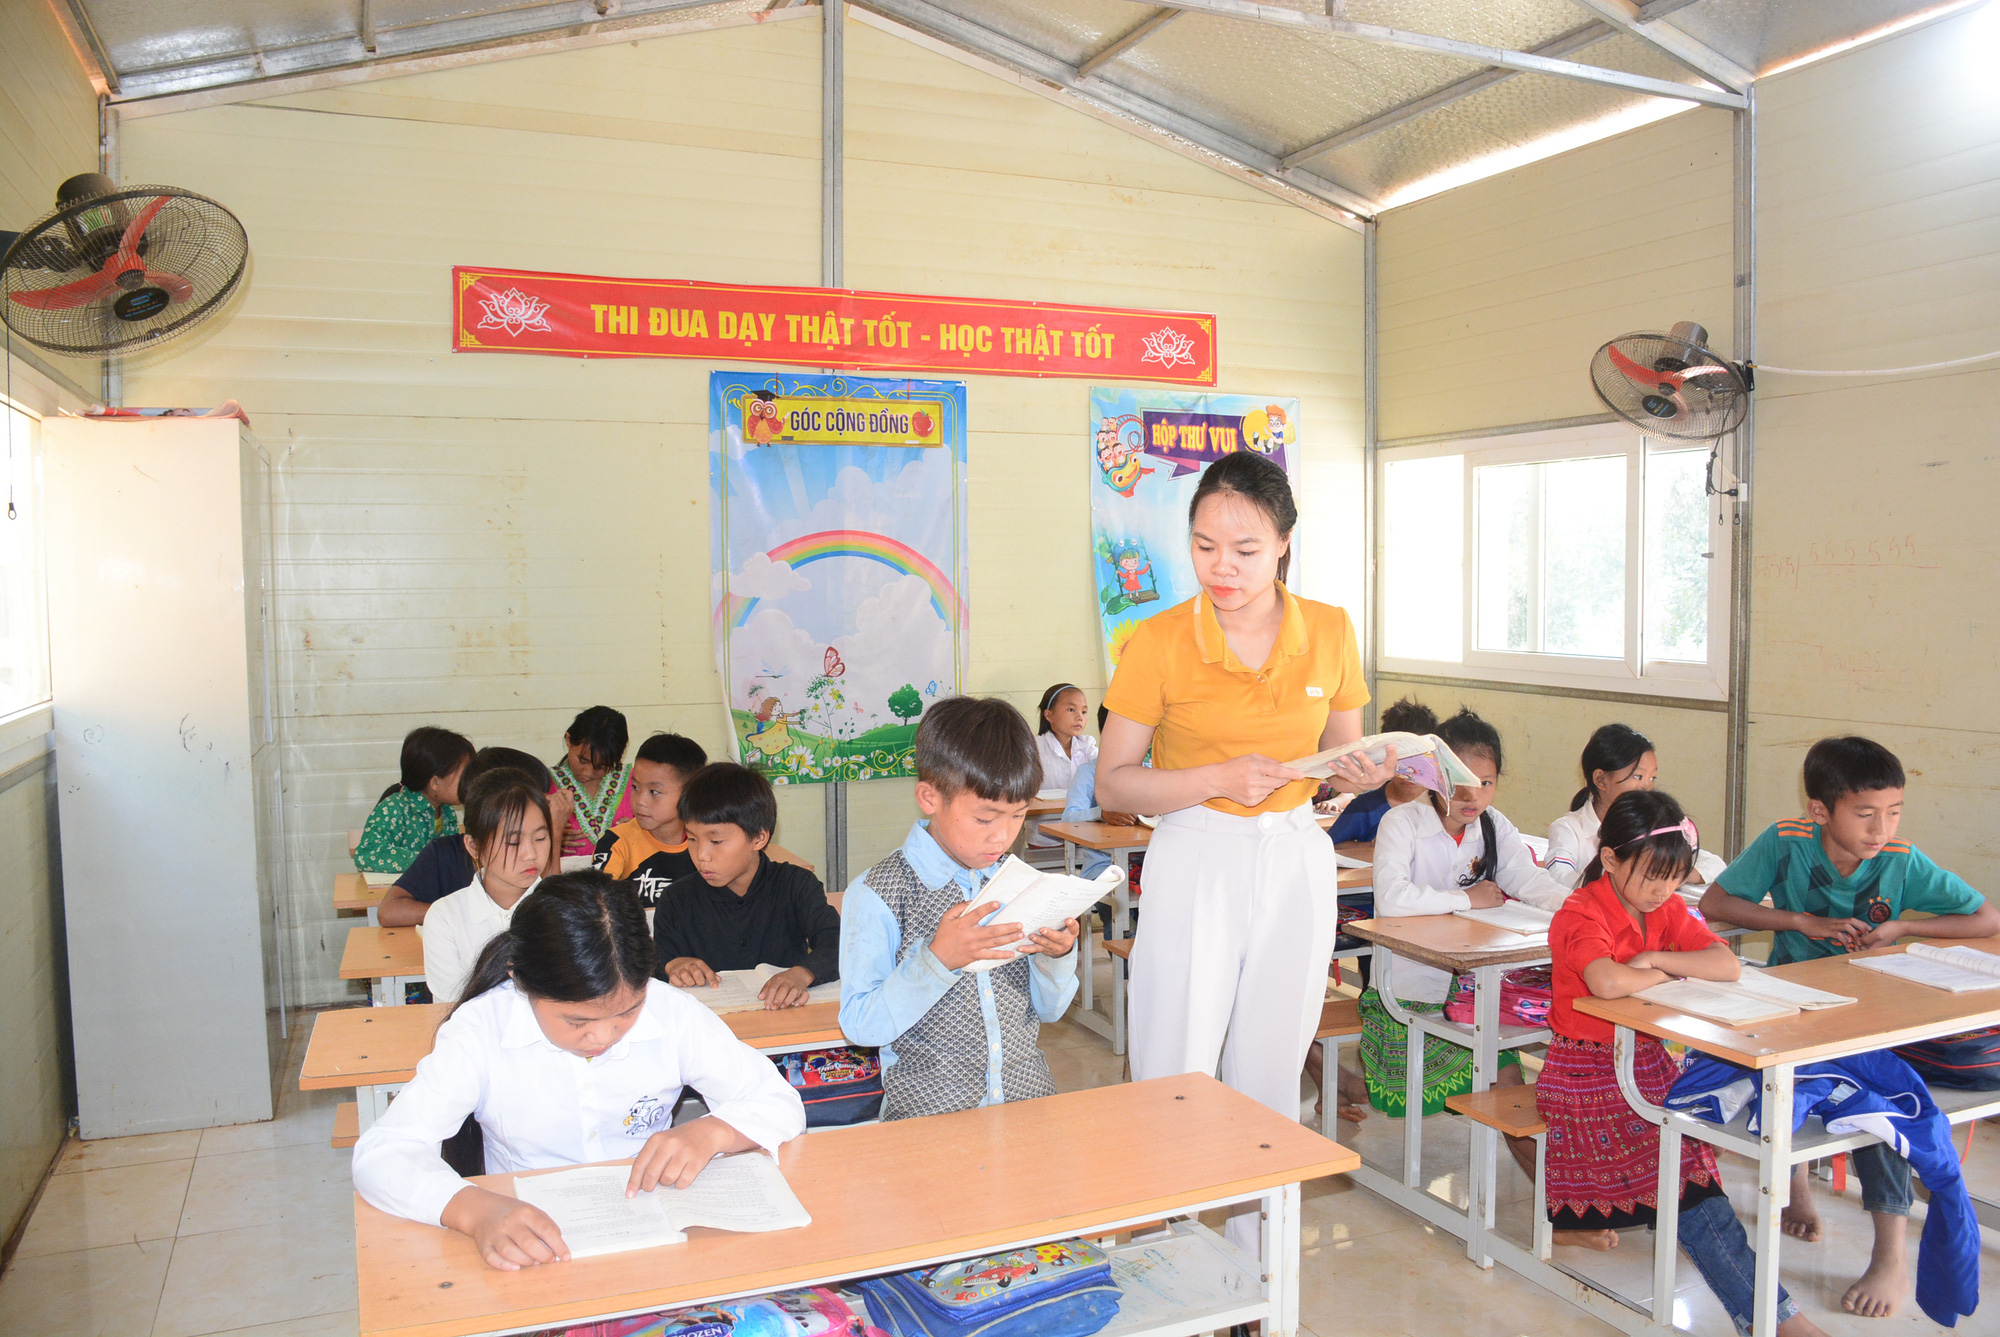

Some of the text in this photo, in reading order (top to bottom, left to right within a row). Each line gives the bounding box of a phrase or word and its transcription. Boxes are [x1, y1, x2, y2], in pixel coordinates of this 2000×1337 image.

[590, 304, 638, 335] THI
[648, 307, 709, 338] ĐUA
[718, 311, 776, 347] DẠY
[785, 310, 855, 350] THẬT
[862, 311, 912, 348] TỐT
[939, 323, 992, 357] HỌC
[1000, 323, 1064, 361] THẬT
[1071, 323, 1115, 359] TỐT
[790, 407, 909, 436] GÓC CỘNG ĐỒNG
[1152, 417, 1238, 454] HỘP THƯ VUI
[672, 1326, 723, 1337] OZEN
